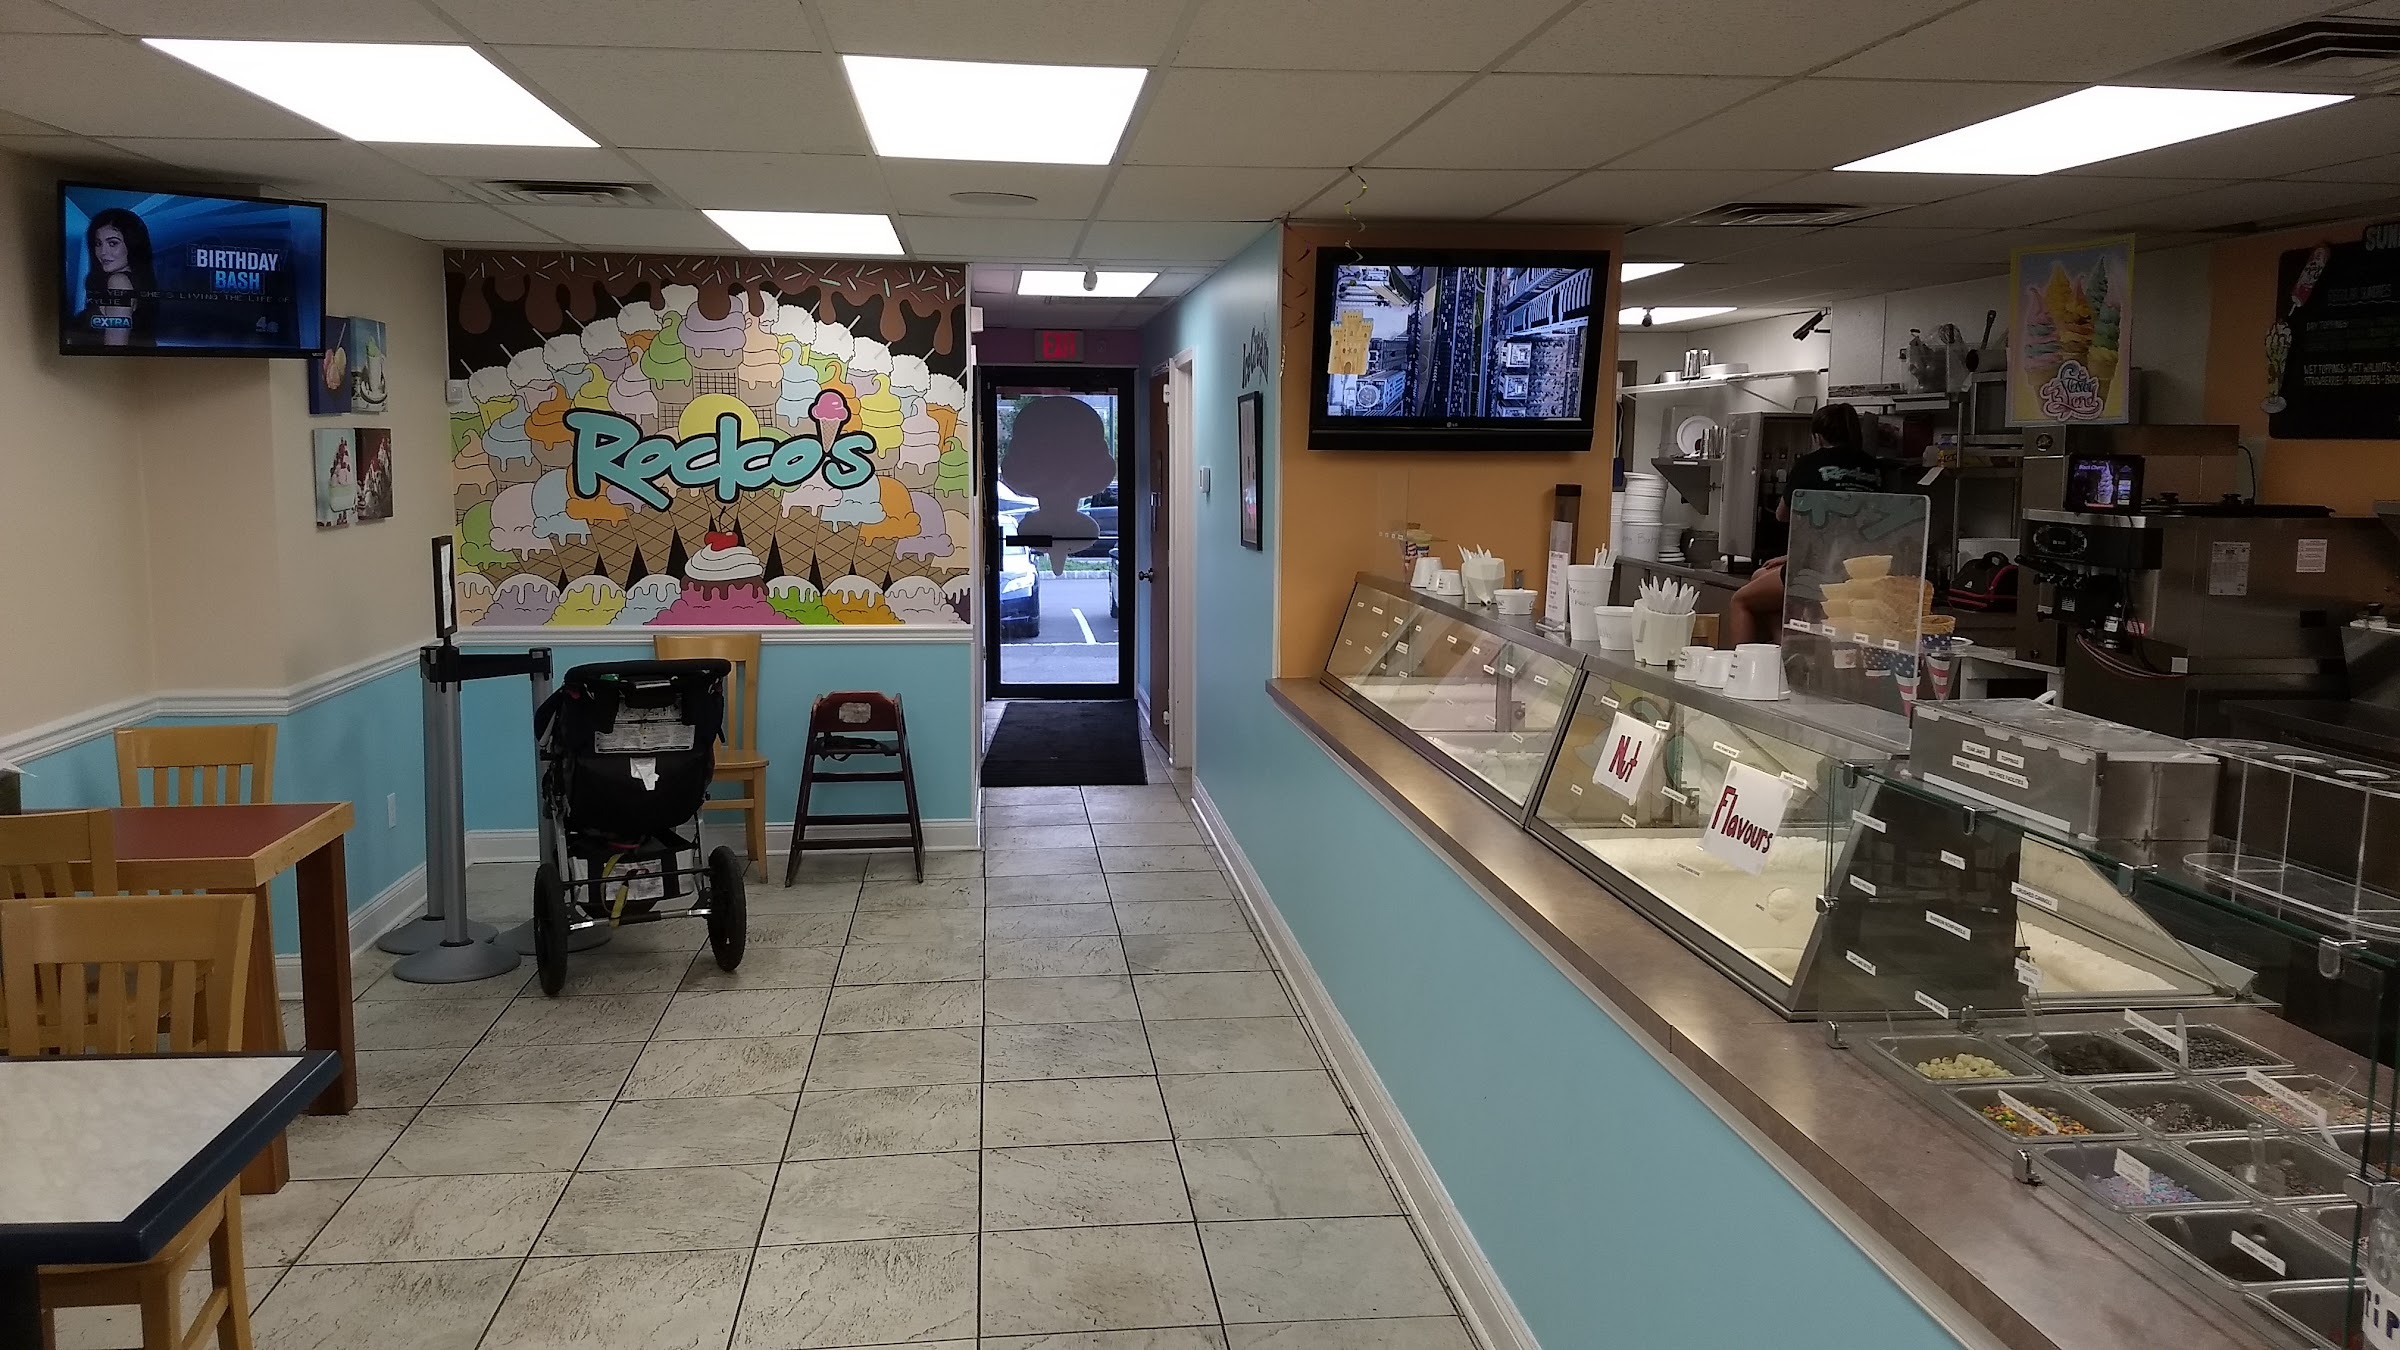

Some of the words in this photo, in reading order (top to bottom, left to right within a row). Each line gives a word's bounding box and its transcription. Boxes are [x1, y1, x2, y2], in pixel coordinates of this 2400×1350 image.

[196, 248, 279, 271] BIRTHDAY
[215, 270, 260, 291] BASH
[1042, 331, 1078, 360] EXIT
[563, 392, 875, 511] Rocko's
[1607, 734, 1642, 783] Nut
[1711, 785, 1774, 854] Flavours
[2253, 1074, 2287, 1098] CHOCOLATE
